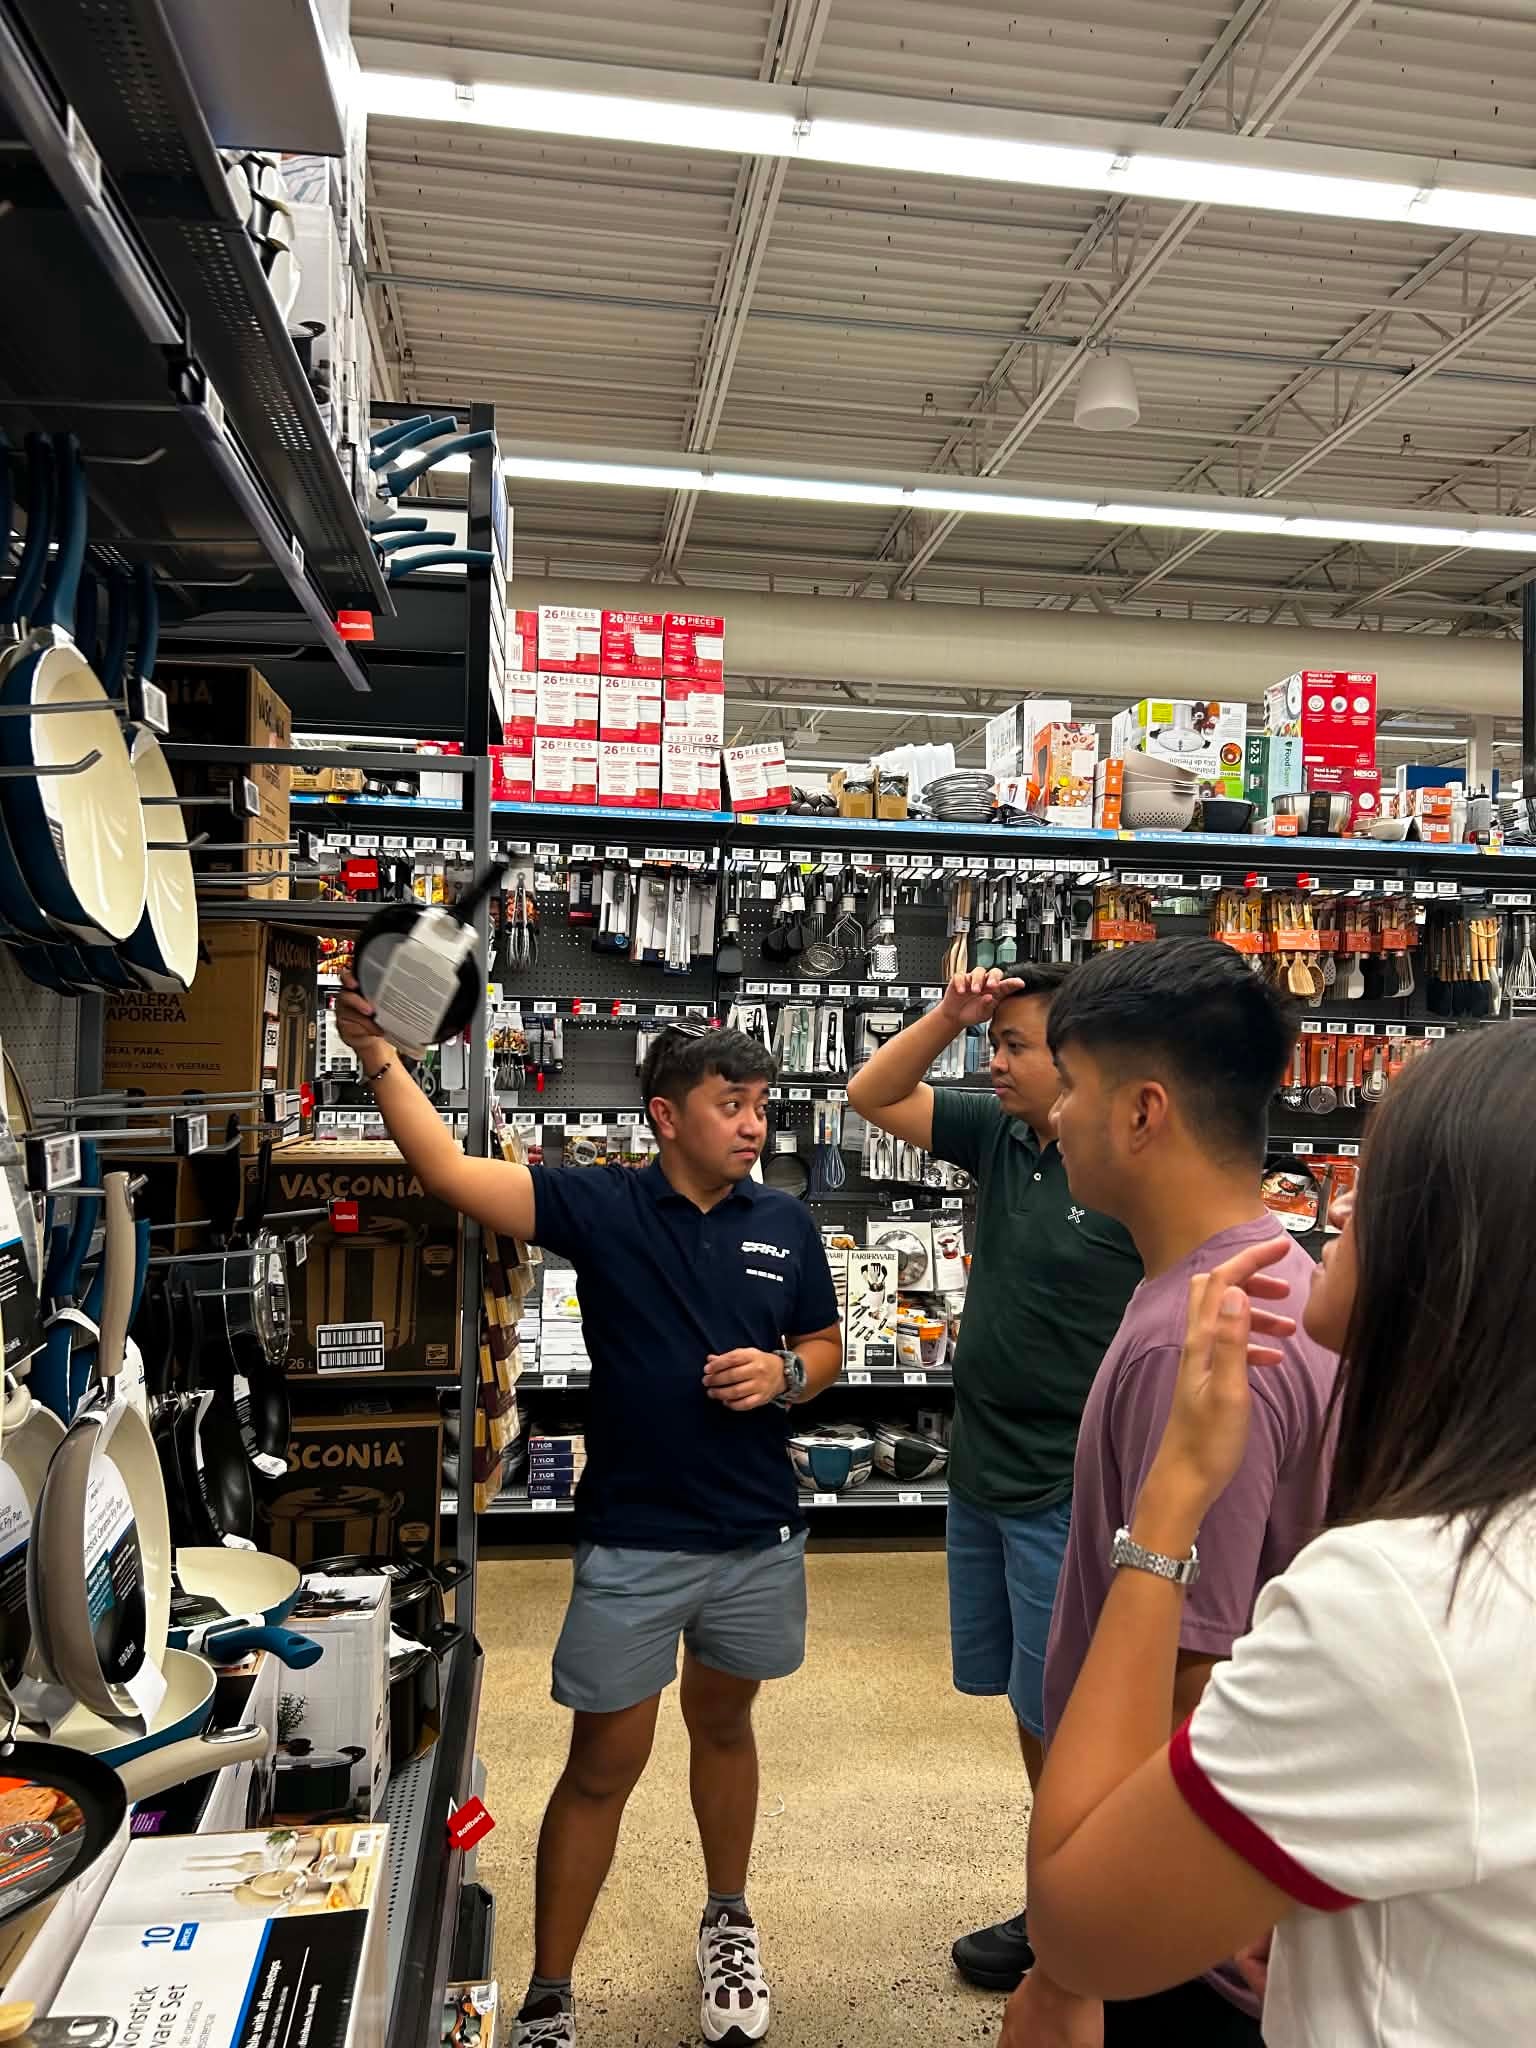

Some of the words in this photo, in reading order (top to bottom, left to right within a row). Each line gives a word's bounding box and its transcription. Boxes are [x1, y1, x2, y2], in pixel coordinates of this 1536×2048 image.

[544, 609, 559, 619] 26
[560, 610, 596, 619] PIECES
[609, 613, 624, 623] 26
[625, 614, 654, 624] PIECES
[672, 615, 686, 625] 26
[687, 616, 716, 626] PIECES
[506, 673, 532, 681] ECES
[543, 675, 558, 684] 26
[560, 676, 594, 684] PIECES
[1347, 674, 1373, 682] NESCO
[605, 678, 620, 688] 26
[621, 679, 656, 688] PIECES
[504, 736, 524, 746] ECES
[705, 734, 719, 743] 26
[540, 740, 556, 750] 26
[557, 741, 593, 749] PIECES
[604, 745, 619, 755] 26
[620, 746, 655, 754] PIECES
[668, 744, 681, 754] 26
[730, 750, 744, 760] 26
[745, 745, 779, 757] PIECES
[1354, 769, 1377, 778] NESCO
[105, 1008, 187, 1023] APORERA
[851, 1252, 897, 1261] FARBERWARE
[287, 1357, 306, 1371] 26
[456, 1810, 487, 1838] Rollback
[141, 1926, 175, 1948] 10
[261, 1960, 283, 2000] stovetops
[160, 1984, 188, 2009] Set
[114, 1985, 160, 2047] onstick
